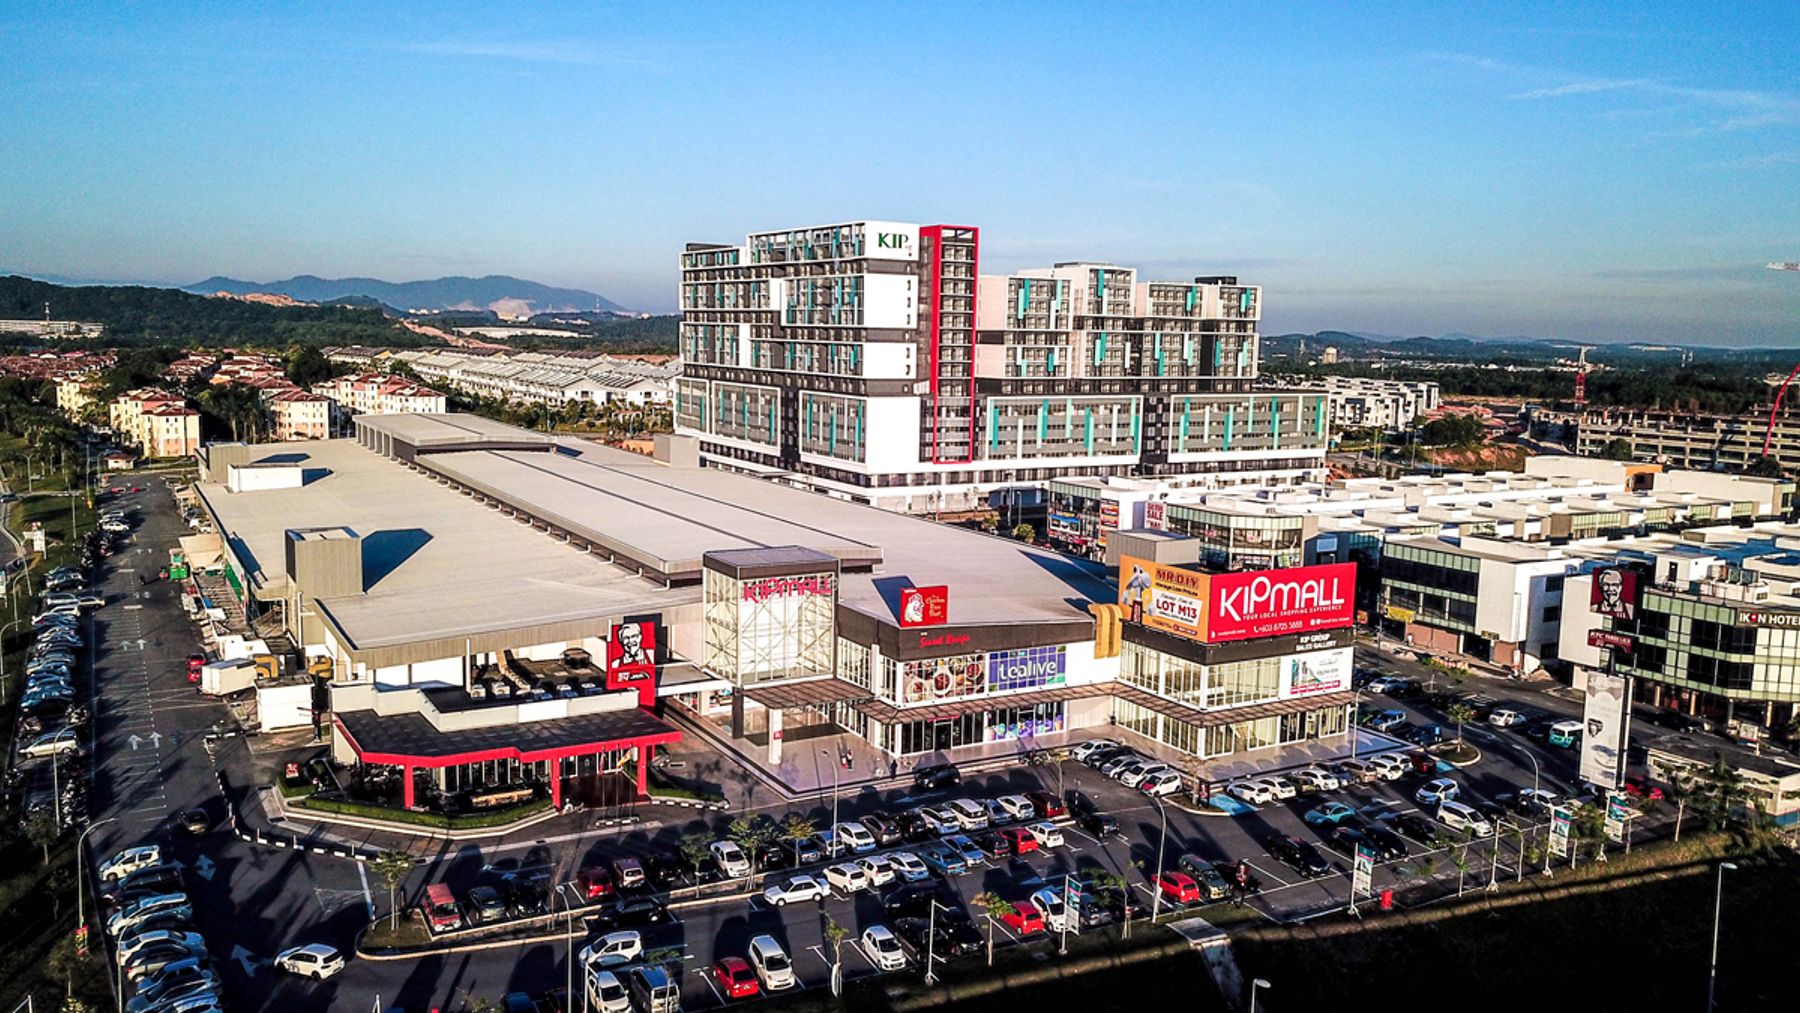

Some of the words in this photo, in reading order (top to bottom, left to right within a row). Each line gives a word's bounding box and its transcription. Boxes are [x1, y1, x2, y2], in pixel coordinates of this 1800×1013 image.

[877, 232, 909, 249] KIP
[1156, 598, 1176, 613] LOT
[1178, 604, 1198, 620] M13
[1243, 613, 1258, 621] YOUR
[1260, 611, 1278, 619] LOCAL
[1280, 607, 1308, 617] SHOPPING
[1309, 604, 1342, 613] EXPERIENCE
[999, 660, 1056, 680] tealive
